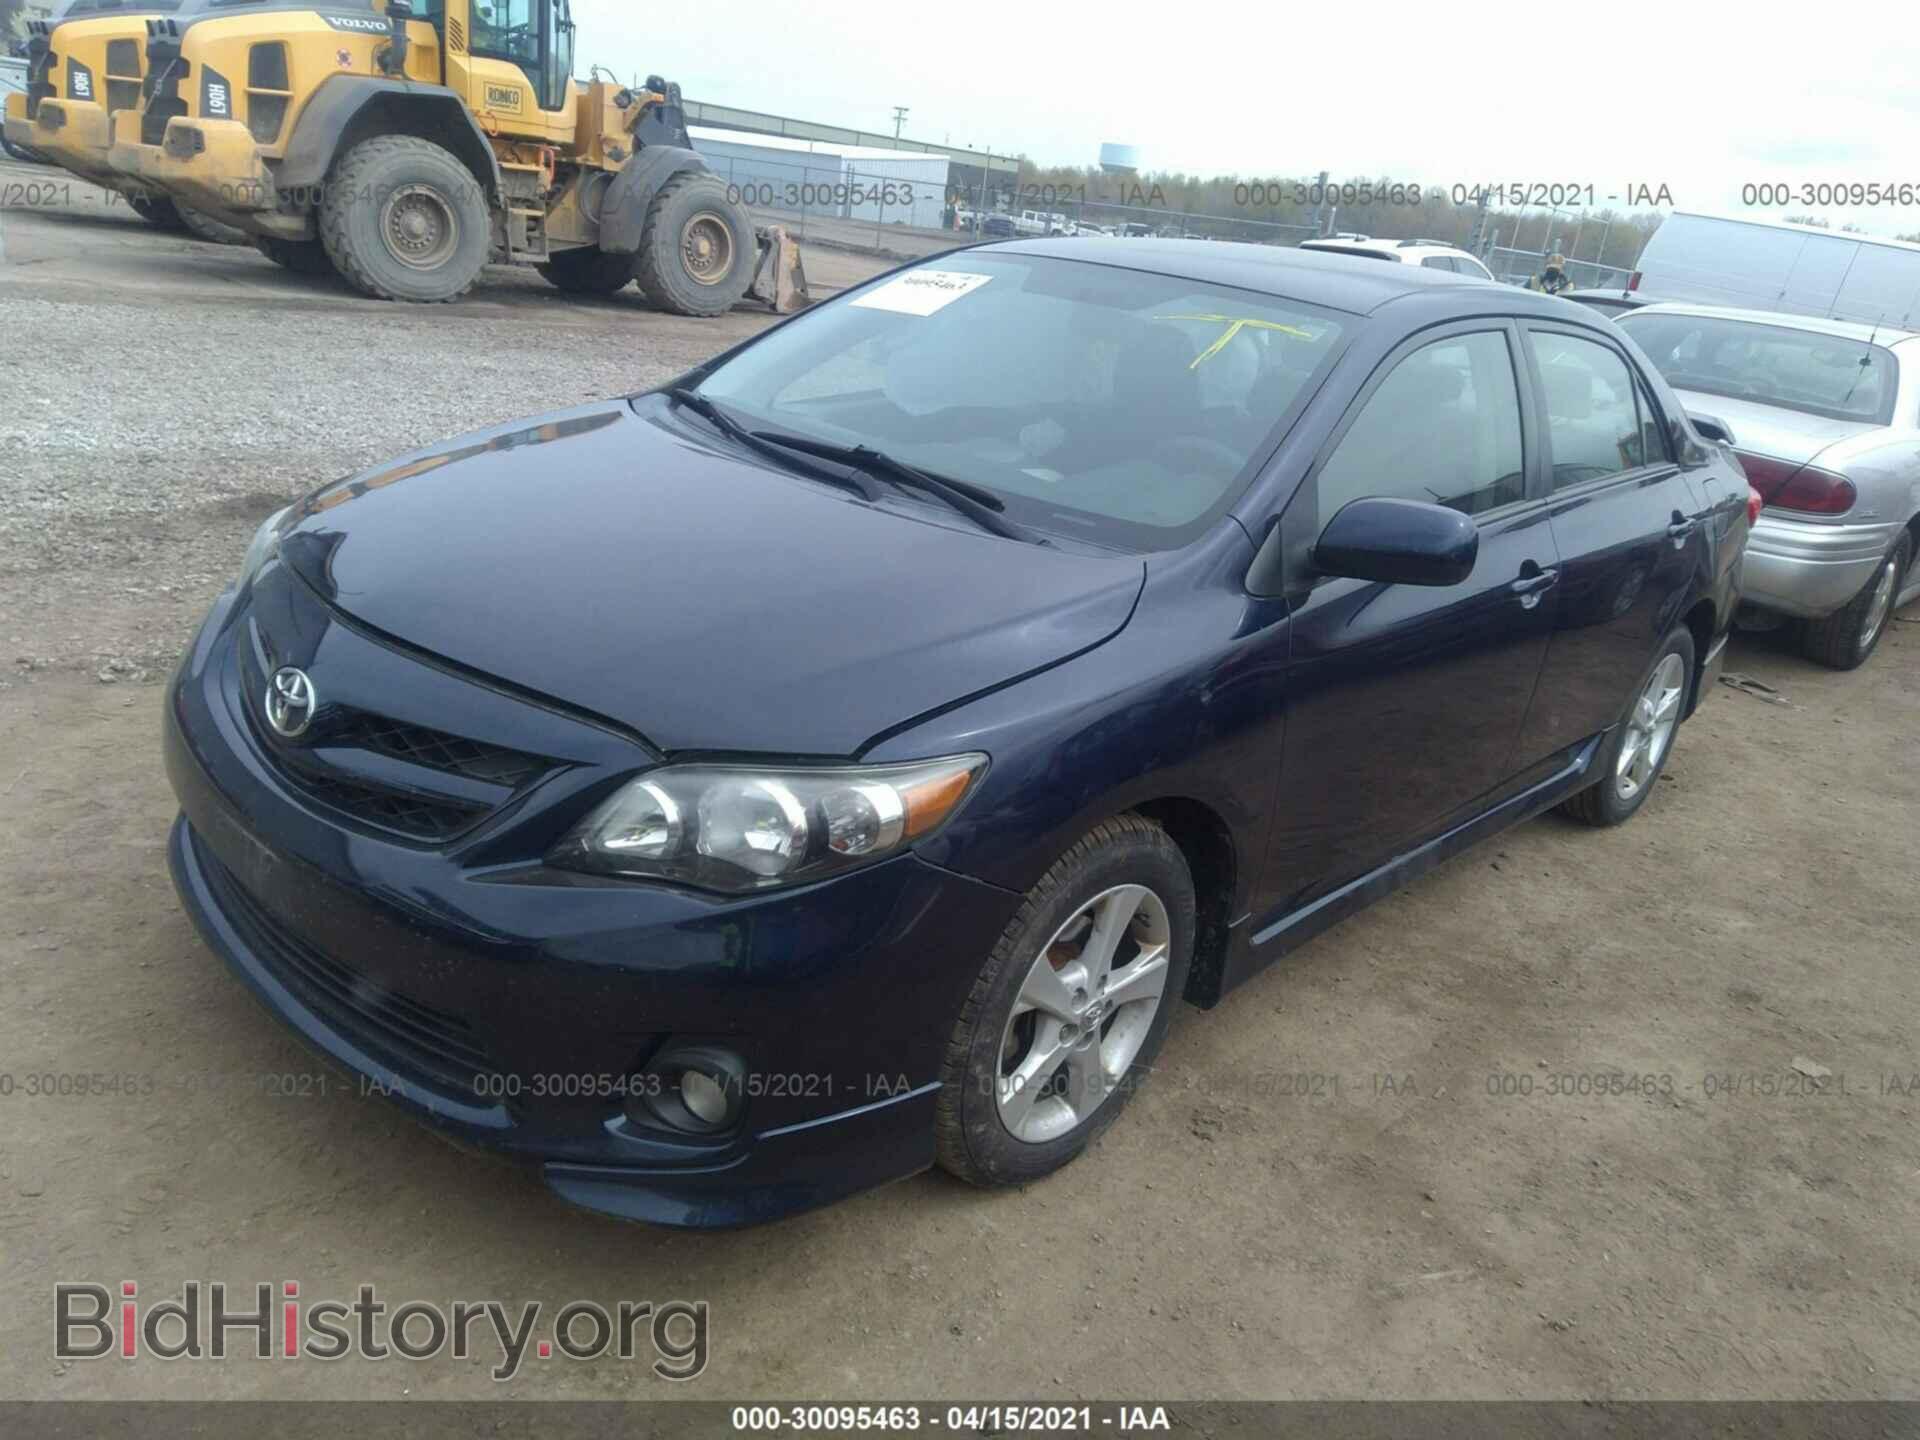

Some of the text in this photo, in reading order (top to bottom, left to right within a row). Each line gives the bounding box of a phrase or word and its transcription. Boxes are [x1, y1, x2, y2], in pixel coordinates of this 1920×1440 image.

[327, 16, 386, 30] VOLVO
[73, 71, 90, 97] L90H
[208, 83, 227, 114] L90H
